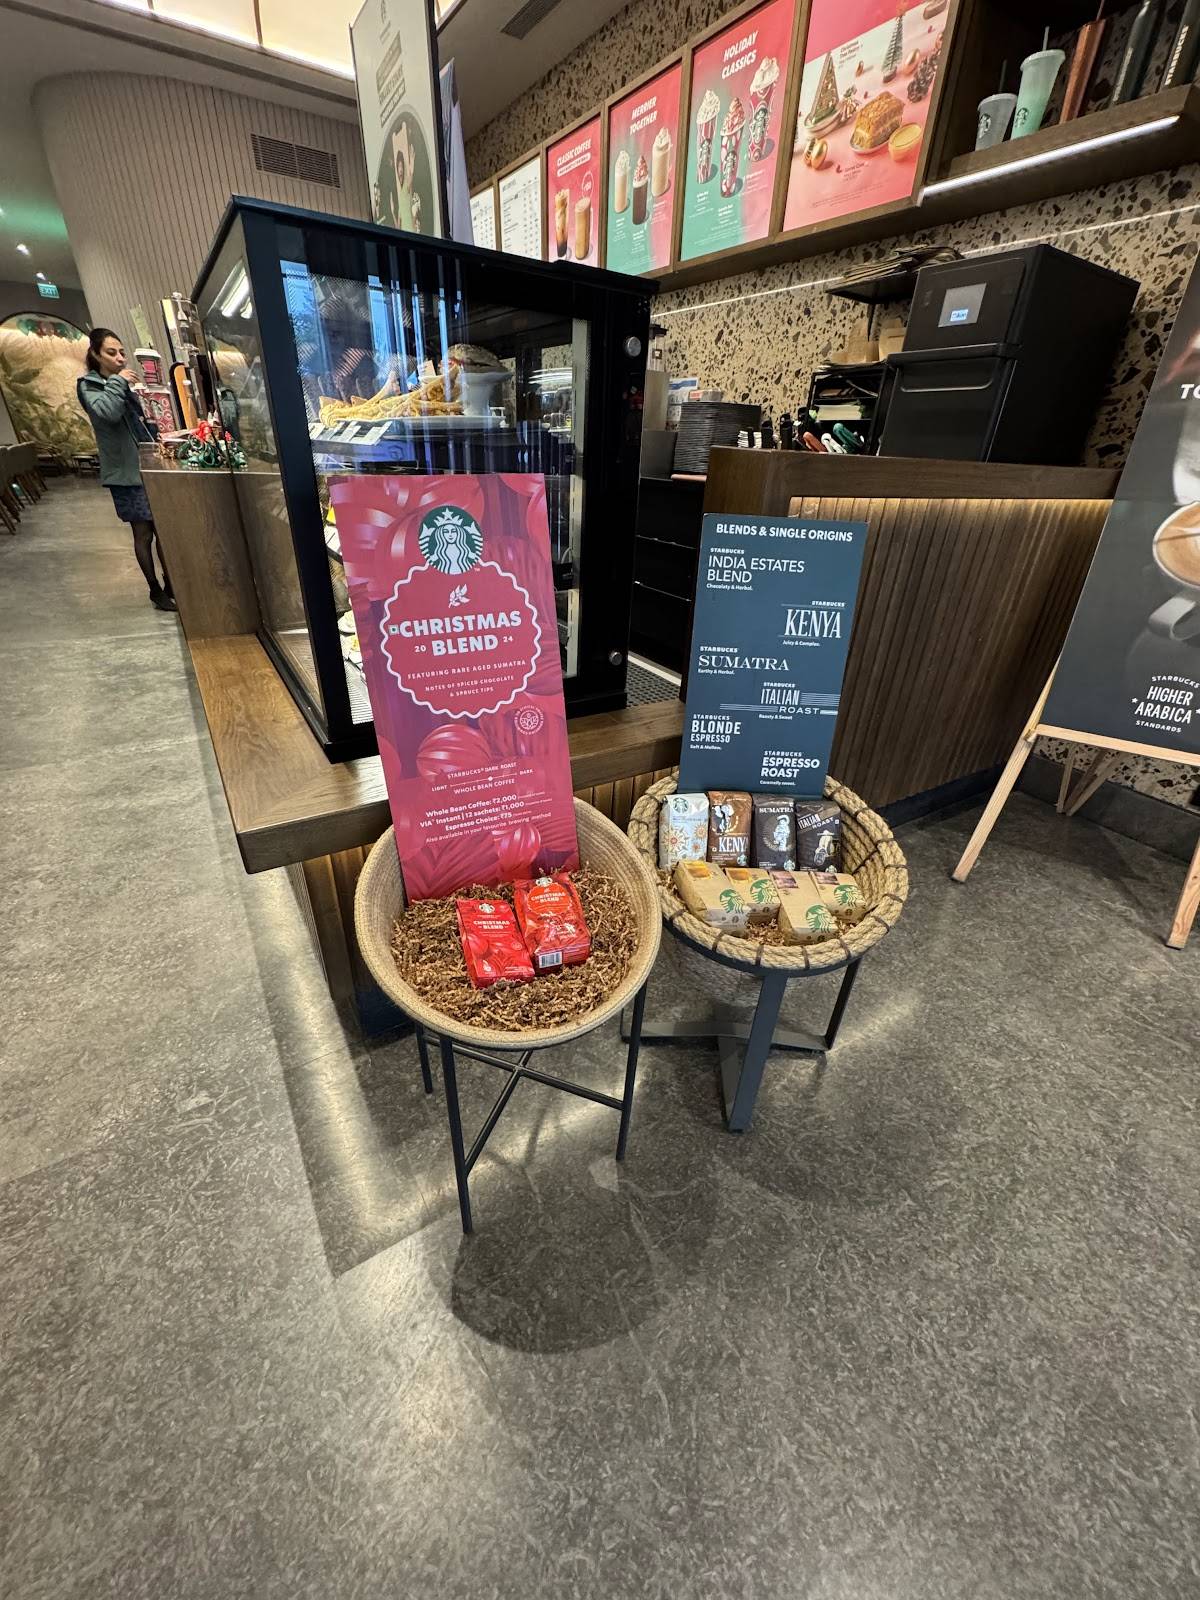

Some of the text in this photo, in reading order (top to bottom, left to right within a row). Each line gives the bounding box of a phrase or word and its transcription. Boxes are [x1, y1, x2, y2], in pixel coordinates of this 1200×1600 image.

[723, 30, 758, 62] HOLIDAY
[721, 49, 757, 79] CLASSICS
[631, 96, 657, 120] MERRIER
[629, 110, 658, 136] TOGETHER
[41, 286, 57, 296] EXIT
[716, 523, 853, 542] BLENDS & SINGLE ORIGINS
[710, 547, 745, 555] STARBUCKS
[708, 555, 805, 573] INDIA ESTATES
[707, 569, 753, 583] BLEND
[811, 600, 845, 608] STARBUCKS
[399, 610, 522, 638] CHRISTMAS
[784, 608, 842, 639] KENYA
[414, 634, 514, 657] 20 BLEND 24
[407, 659, 526, 680] FEATURING RARE AGED SUMATRA
[698, 655, 790, 671] SUMATRA
[456, 680, 478, 688] SPICED
[480, 675, 514, 685] CHOCOLATE
[480, 686, 494, 694] TIPS
[1151, 675, 1200, 688] STARBUCKS
[760, 688, 800, 706] ITALIAN
[1146, 685, 1194, 706] HIGHER
[778, 706, 820, 715] ROAST
[1134, 701, 1192, 724] ARABICA
[691, 720, 741, 735] BLONDE
[1135, 720, 1182, 733] STANDARDS
[690, 733, 731, 743] ESPRESSO
[485, 765, 499, 773] DARK
[500, 762, 517, 770] ROAST
[762, 757, 820, 768] ESPRESSO
[760, 768, 800, 778] ROAST
[453, 778, 515, 795] WHOLE BEAN COFFEE
[426, 808, 449, 818] Whole
[449, 804, 467, 813] Bean
[467, 800, 492, 809] Coffee:
[492, 794, 517, 804] ₹2,000
[436, 814, 461, 825] Instant
[501, 801, 525, 811] ₹1,000
[445, 821, 475, 832] Espresso
[475, 815, 499, 825] Choice:
[812, 817, 834, 829] ROAST
